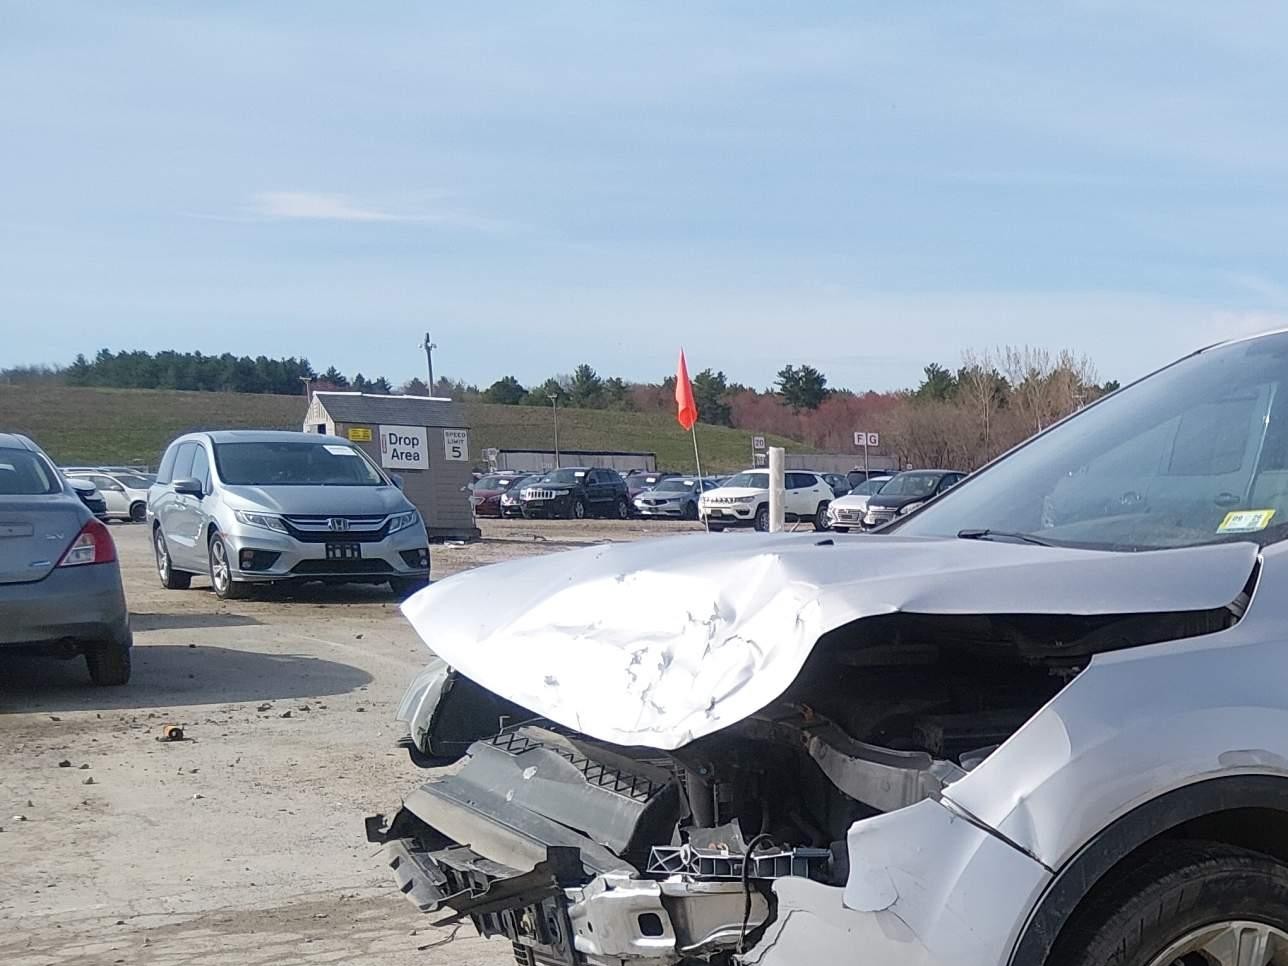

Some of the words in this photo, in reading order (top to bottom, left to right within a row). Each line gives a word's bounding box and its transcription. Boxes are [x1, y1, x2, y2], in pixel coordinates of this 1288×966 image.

[388, 433, 420, 448] Drop
[857, 434, 863, 442] F
[869, 434, 876, 444] G
[391, 448, 420, 461] Area
[452, 446, 462, 458] 5
